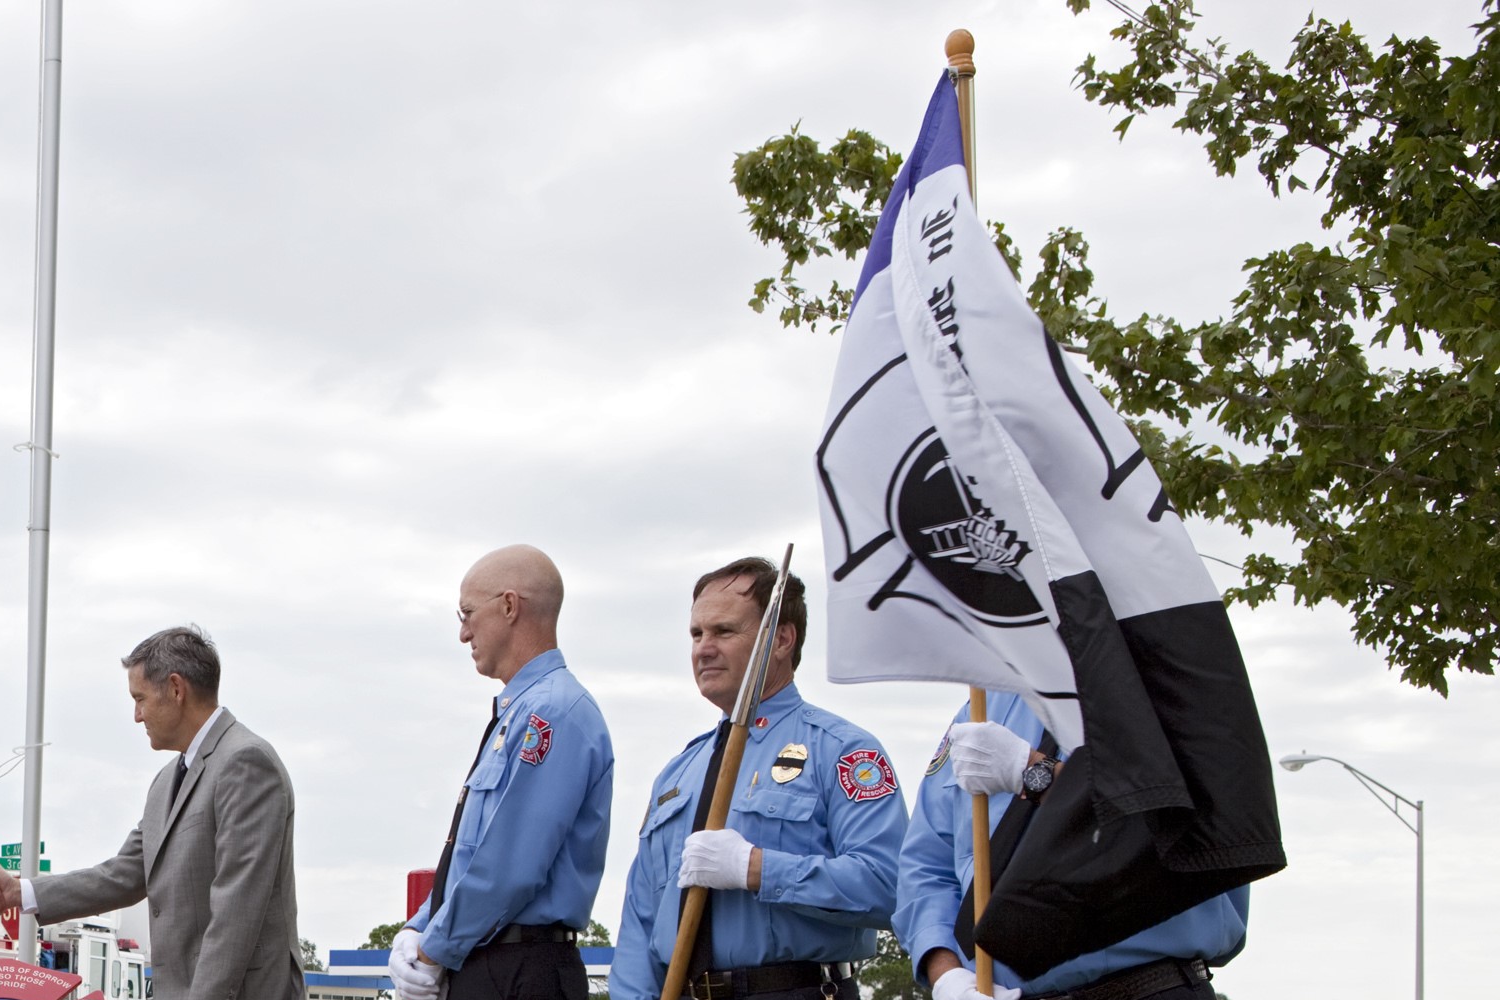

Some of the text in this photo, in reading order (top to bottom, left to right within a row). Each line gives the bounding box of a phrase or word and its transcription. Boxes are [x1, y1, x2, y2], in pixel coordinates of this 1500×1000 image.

[852, 752, 869, 760] FIRE
[841, 771, 853, 790] NASA
[860, 786, 888, 797] RESCUE
[15, 974, 46, 987] THOSE
[32, 970, 71, 989] SORROW
